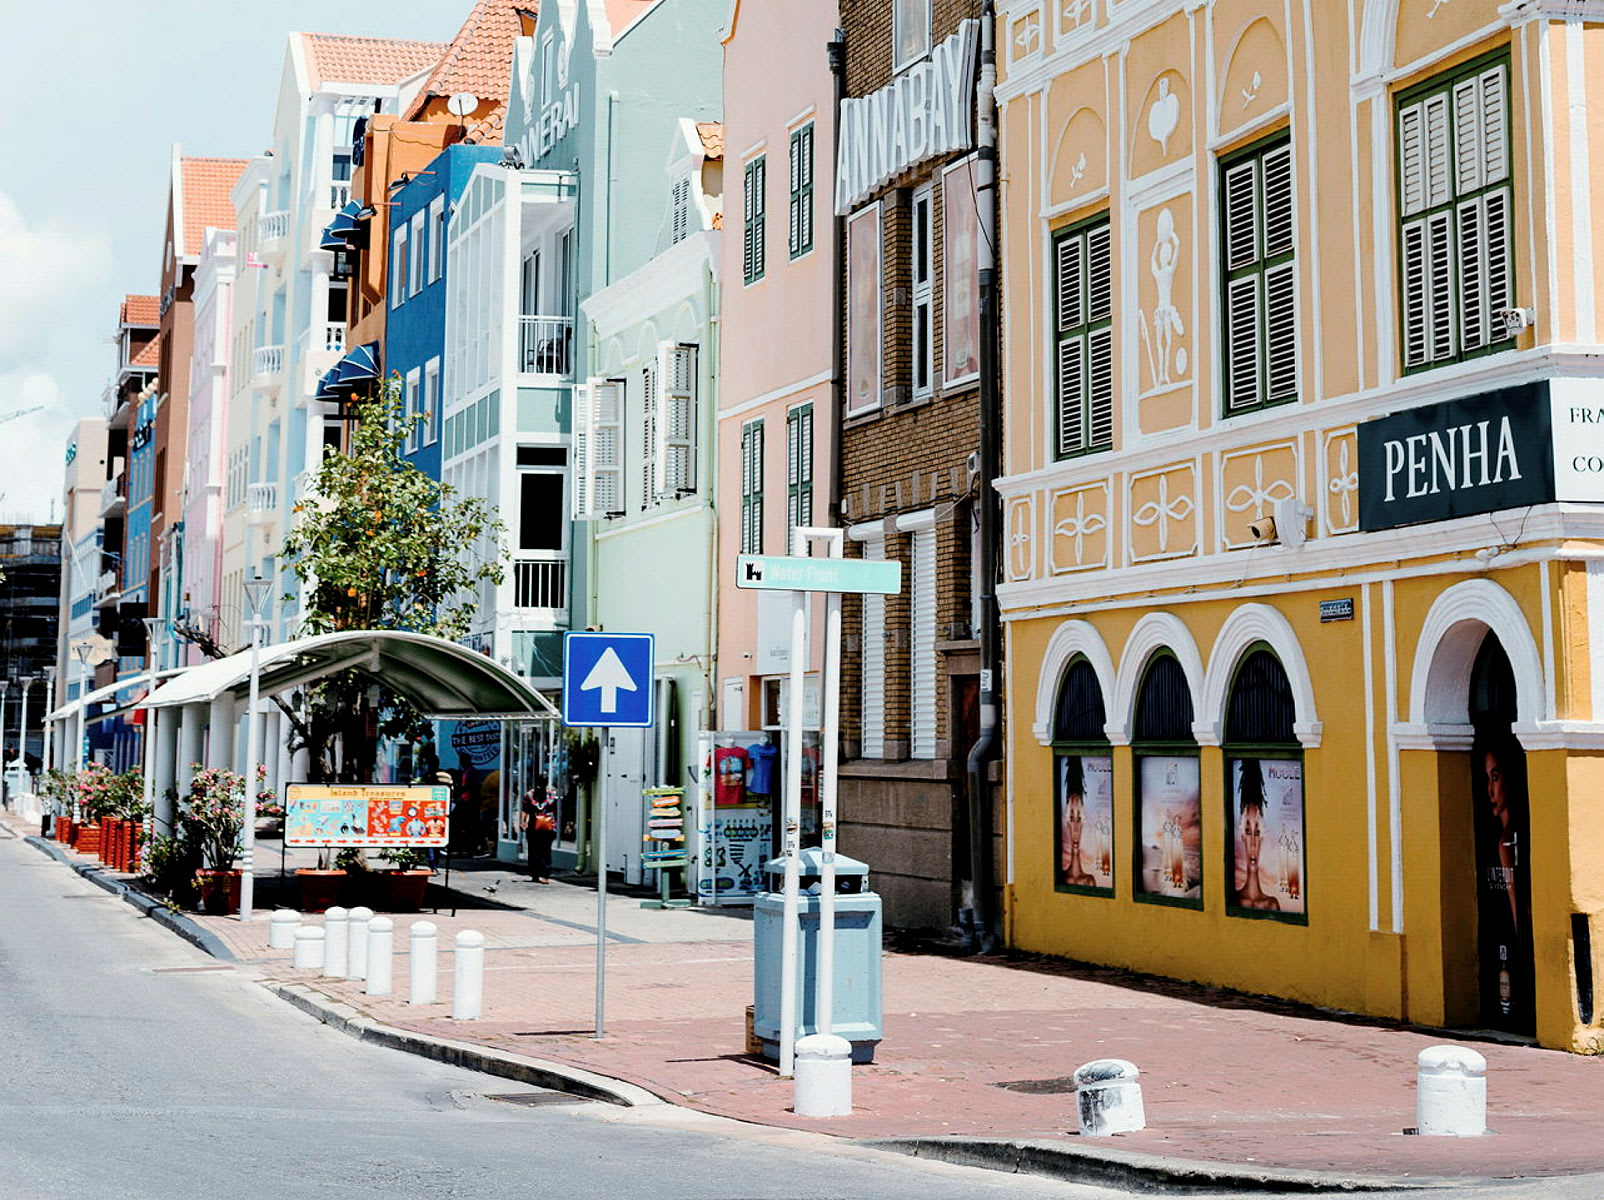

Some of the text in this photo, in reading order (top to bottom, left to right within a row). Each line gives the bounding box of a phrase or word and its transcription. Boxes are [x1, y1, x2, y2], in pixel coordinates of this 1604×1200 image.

[515, 82, 580, 167] ANERAI
[835, 18, 981, 217] ANNABAY
[1384, 415, 1522, 502] PENHA
[468, 733, 484, 744] BEST
[360, 787, 406, 797] Treasures
